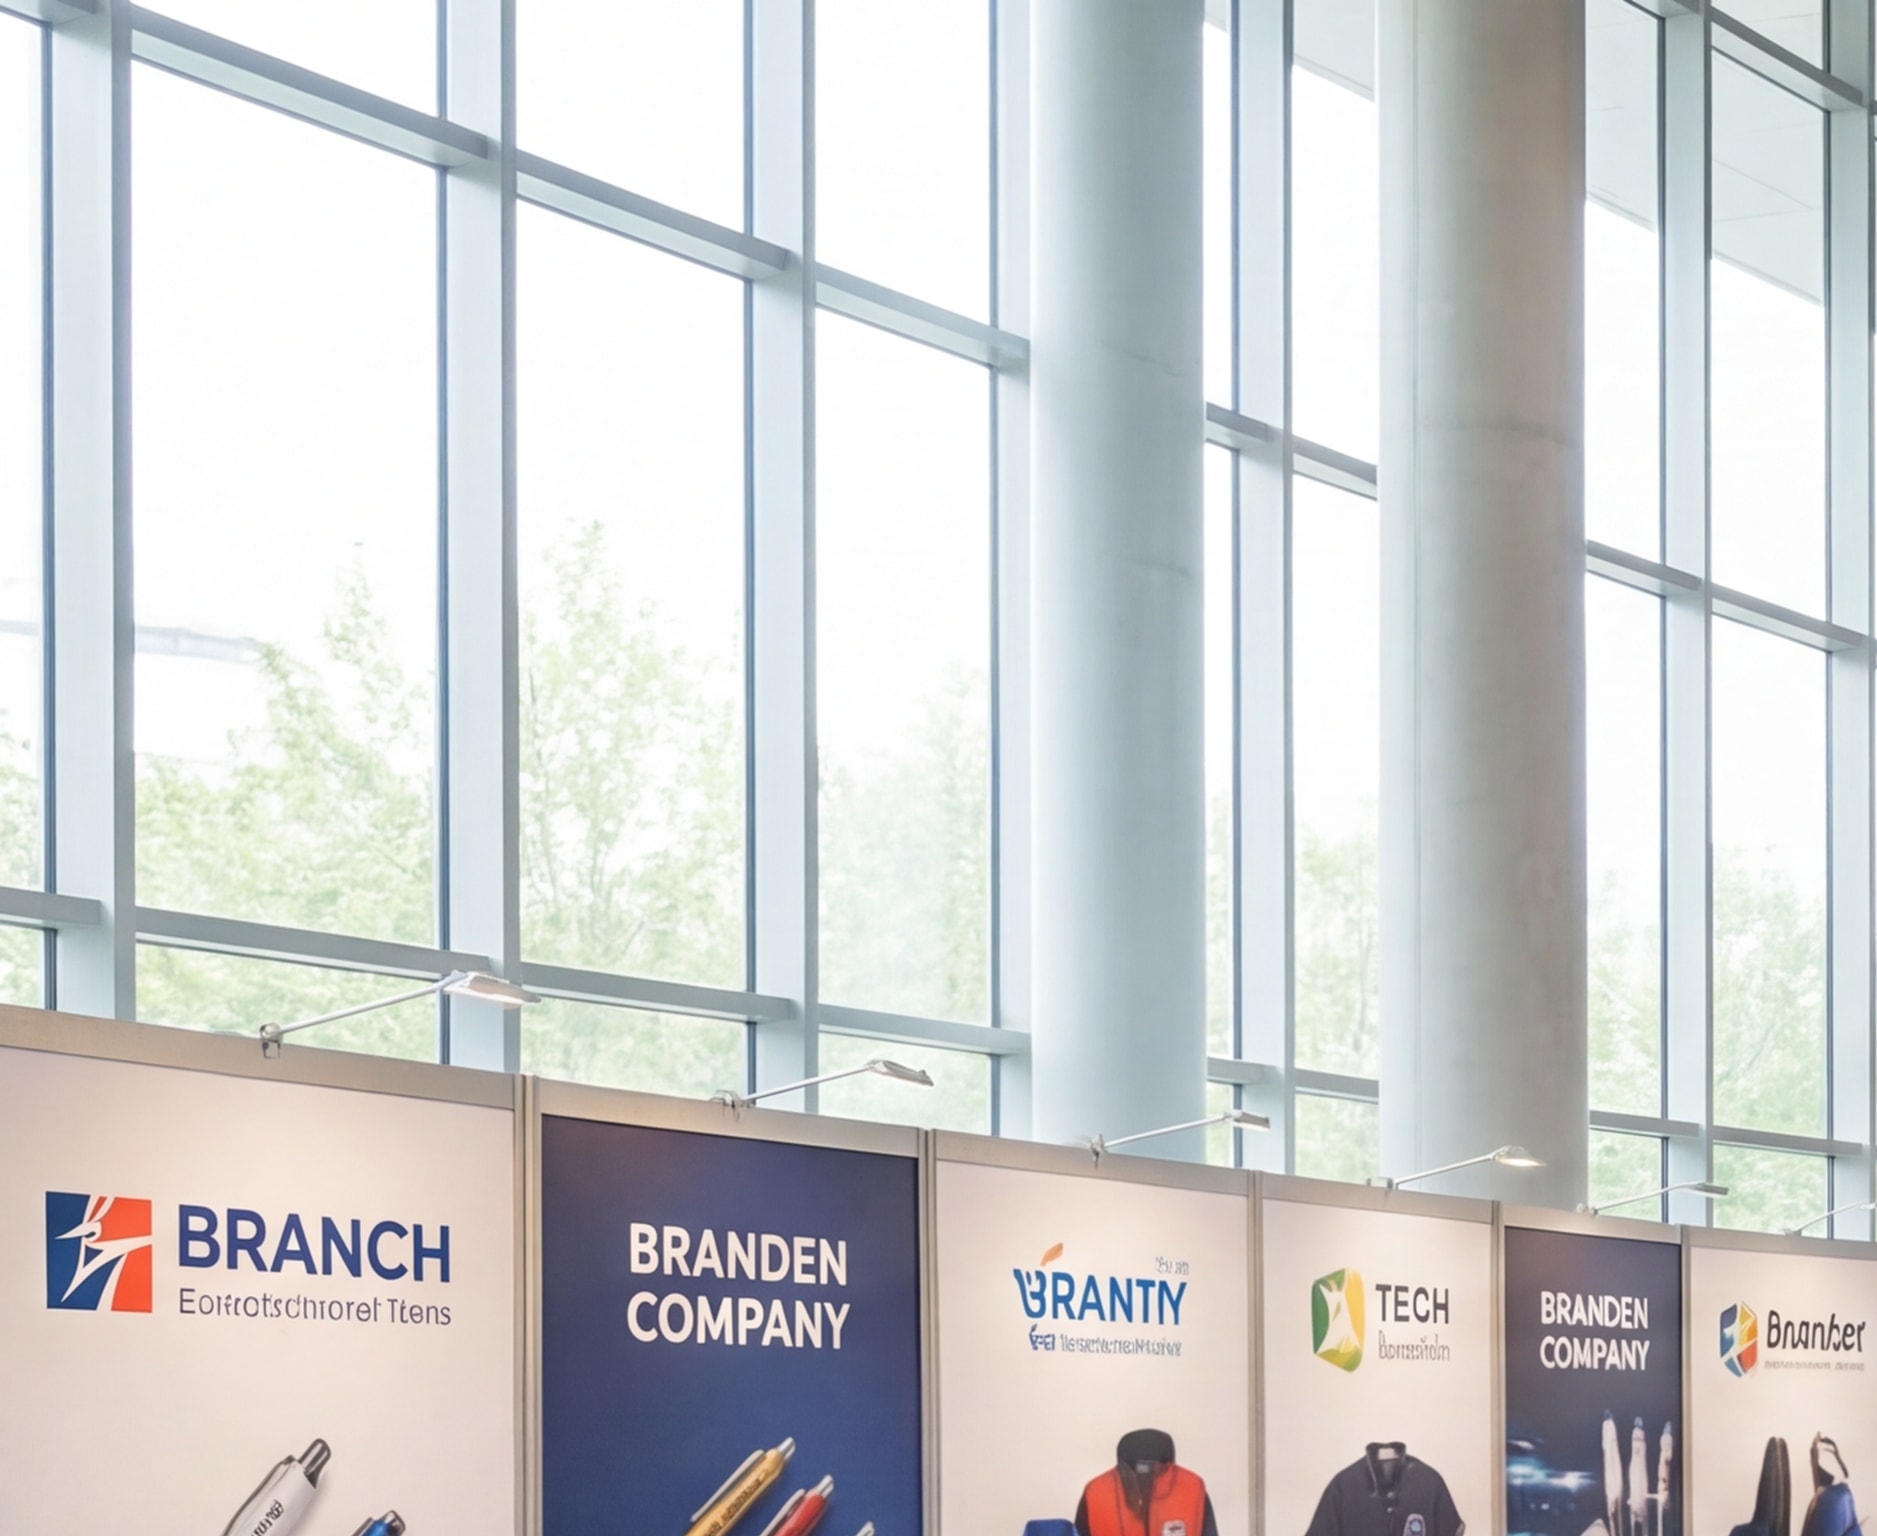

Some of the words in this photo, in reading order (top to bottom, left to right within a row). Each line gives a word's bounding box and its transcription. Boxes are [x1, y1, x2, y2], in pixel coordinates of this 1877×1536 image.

[179, 1204, 450, 1283] BRANCH
[629, 1223, 848, 1286] BRANDEN
[626, 1291, 851, 1349] COMPANY
[1375, 1283, 1449, 1325] TECH
[1540, 1290, 1648, 1330] BRANDEN
[1540, 1335, 1650, 1371] COMPANY
